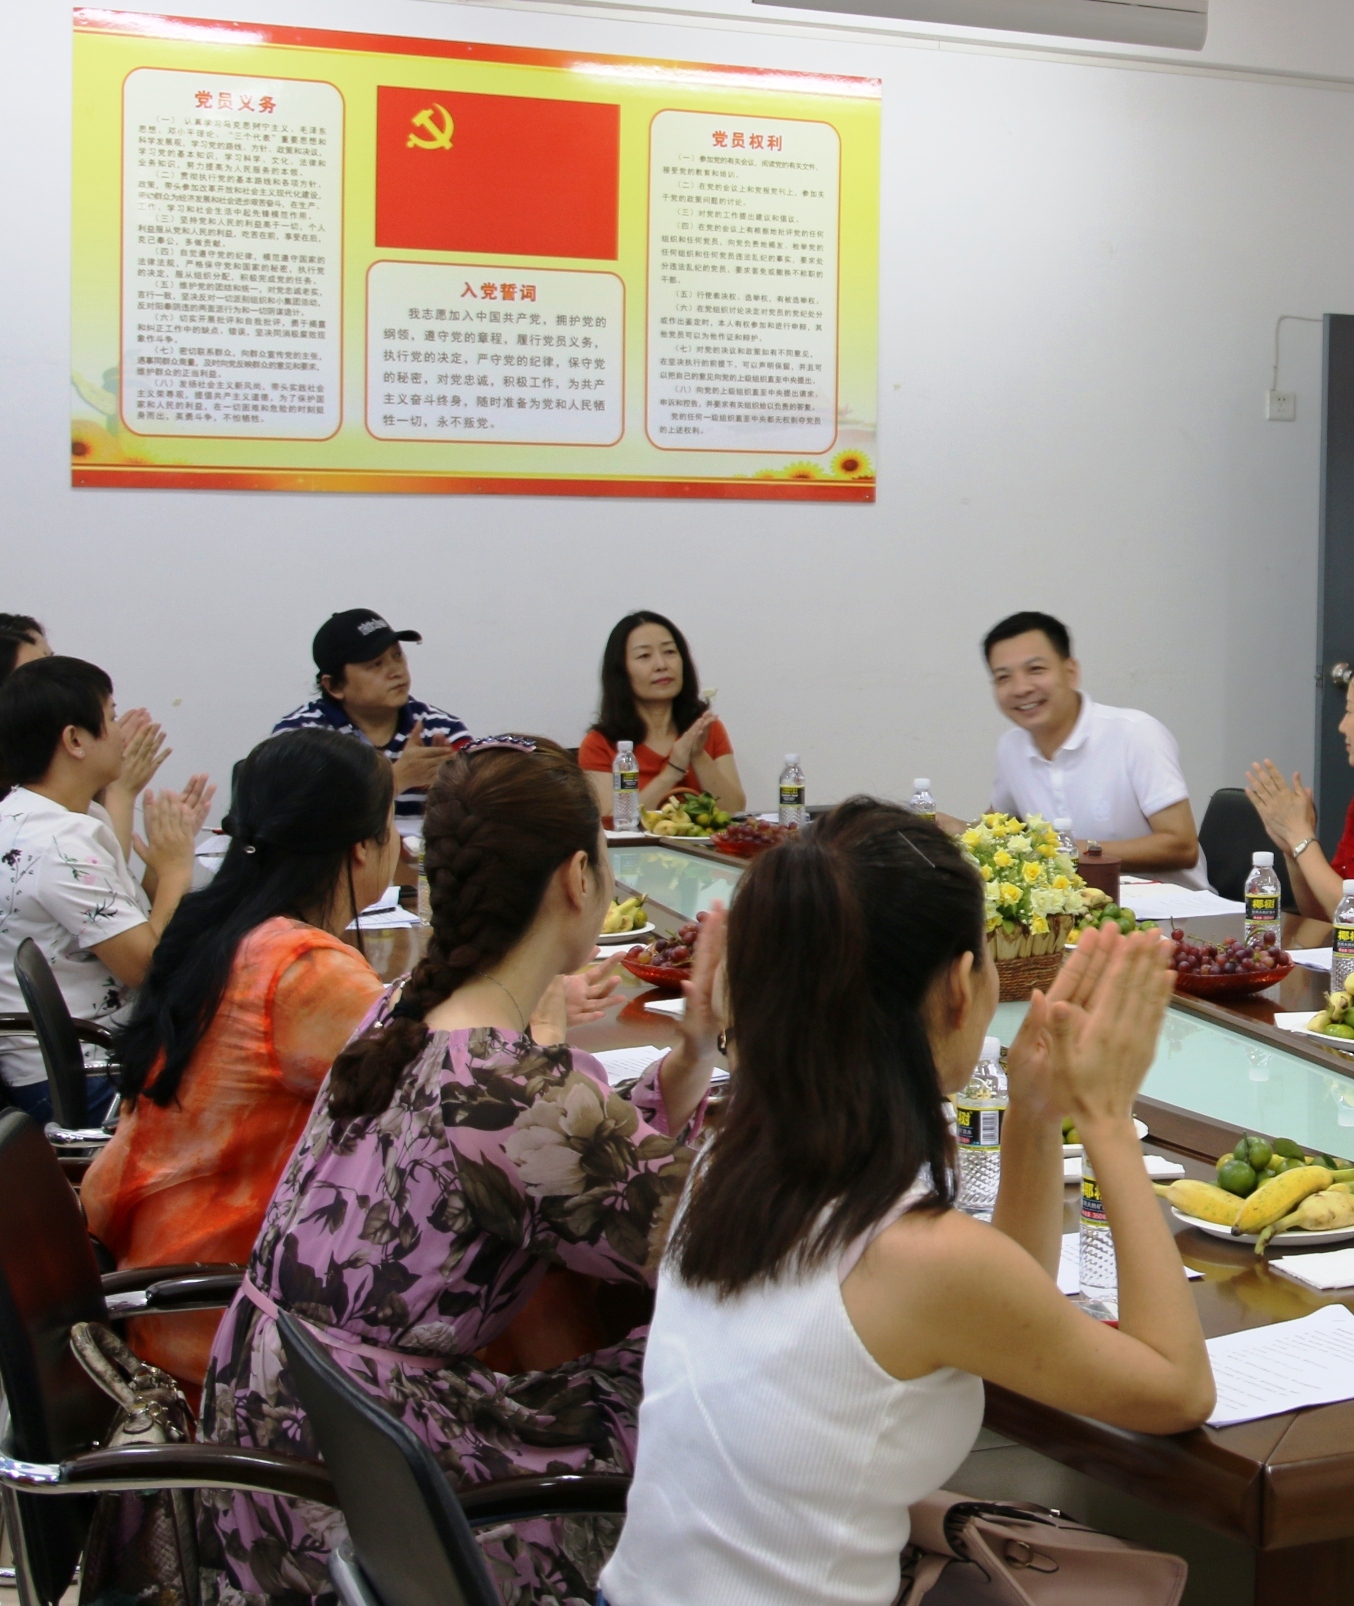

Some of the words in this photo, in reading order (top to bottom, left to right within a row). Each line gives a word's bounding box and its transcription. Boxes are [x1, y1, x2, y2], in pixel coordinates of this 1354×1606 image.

[195, 90, 276, 113] 党员义务
[712, 130, 782, 151] 党员权利
[461, 282, 537, 302] 入党誓词
[409, 308, 607, 328] 我志愿加入中国共产党，拥护党的
[384, 328, 600, 348] 纲领，遵守党的章程，履行党员义务，
[384, 350, 605, 370] 执行党的决定，严守党的纪律，保守党
[384, 371, 605, 390] 的秘密，对党忠诚，积极工作，为共产
[384, 393, 605, 411] 主义奋斗终身，随时准备为党和人民牺
[384, 415, 496, 429] 牲一切，永不叛党。
[1252, 899, 1275, 909] 椰树
